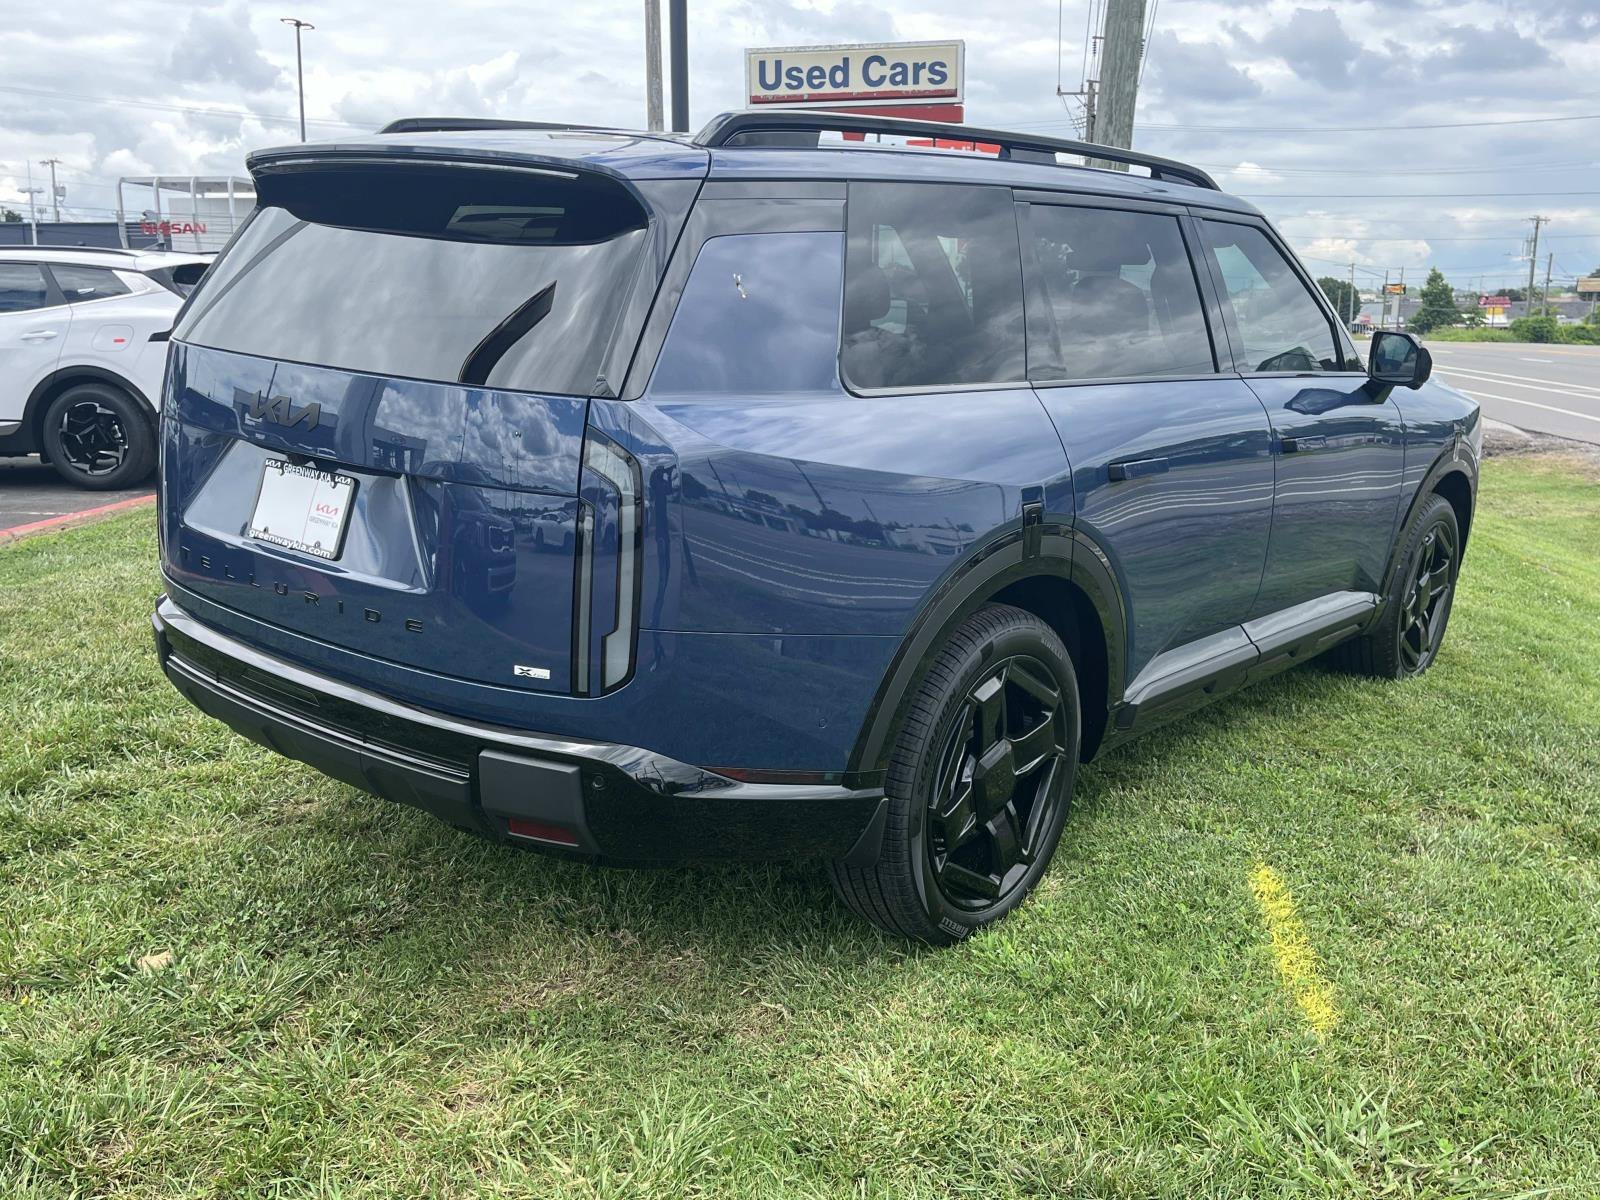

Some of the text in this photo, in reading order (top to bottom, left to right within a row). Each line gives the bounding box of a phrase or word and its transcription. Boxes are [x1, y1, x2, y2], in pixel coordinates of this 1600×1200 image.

[758, 55, 949, 91] Used Cars
[141, 222, 207, 236] NISSAN
[283, 463, 320, 480] GREENWAY
[248, 529, 331, 558] greenwaykia.com
[181, 545, 424, 633] TELLURIDE
